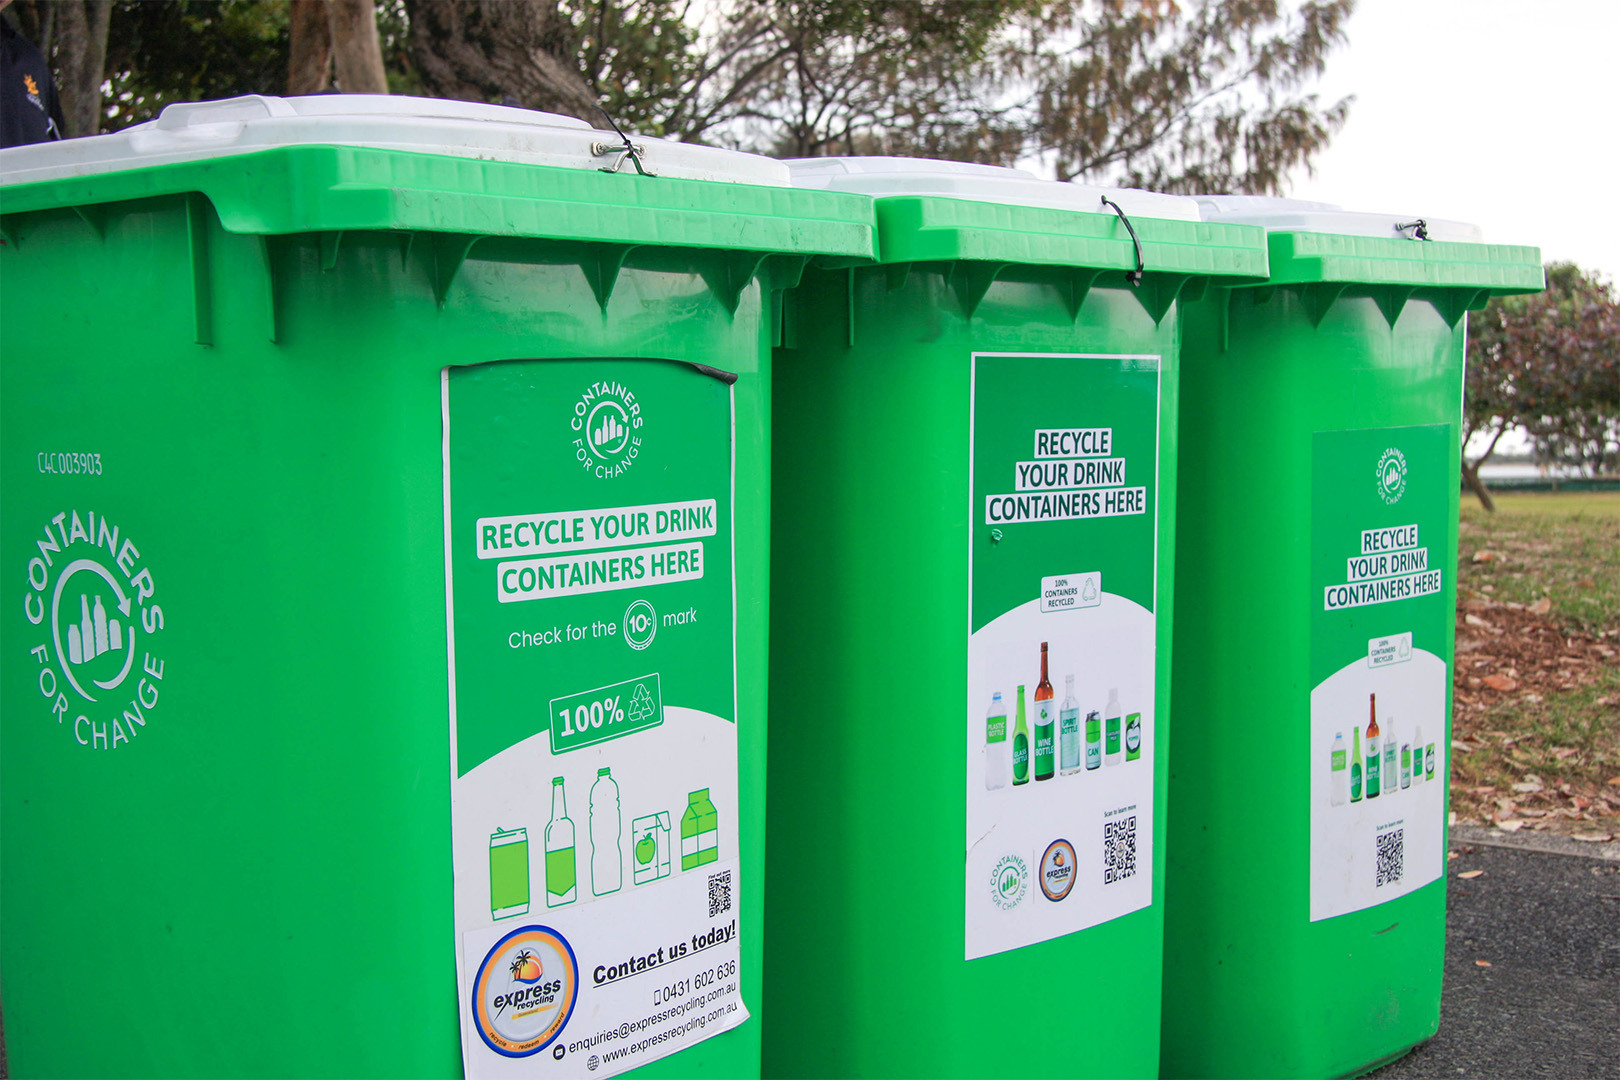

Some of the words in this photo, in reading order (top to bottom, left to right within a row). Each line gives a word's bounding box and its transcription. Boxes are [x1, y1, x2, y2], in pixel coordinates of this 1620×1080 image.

[571, 381, 643, 431] CONTAINERS
[572, 438, 593, 471] FOR
[595, 436, 642, 479] CHANGE
[1038, 431, 1109, 455] RECYCLE
[1018, 462, 1068, 488] YOUR
[1074, 460, 1123, 485] DRINK
[1376, 447, 1408, 478] CONTAINERS
[989, 492, 1100, 521] CONTAINERS
[1105, 489, 1143, 514] HERE
[482, 518, 584, 550] RECYCLE
[591, 512, 650, 540] YOUR
[656, 505, 713, 534] DRINK
[1364, 527, 1416, 552] RECYCLE
[25, 509, 164, 634] CONTAINERS
[502, 555, 645, 594] CONTAINERS
[651, 549, 700, 578] HERE
[1350, 556, 1388, 579] YOUR
[1391, 550, 1426, 573] DRINK
[1044, 587, 1078, 598] CONTAINERS
[1055, 579, 1069, 587] 100%
[1327, 578, 1411, 608] CONTAINERS
[1413, 572, 1439, 594] HERE
[1048, 597, 1075, 607] RECYCLED
[508, 627, 562, 649] Check
[566, 624, 588, 642] for
[592, 620, 617, 638] the
[663, 607, 697, 627] mark
[30, 644, 69, 724] FOR
[74, 652, 165, 750] CHANGE
[559, 696, 625, 737] 100%
[1037, 737, 1052, 748] WINE
[1087, 747, 1099, 757] CAN
[990, 854, 1028, 886] CONTAINERS
[1046, 866, 1072, 880] express
[593, 946, 664, 984] Contact
[668, 942, 687, 960] us
[691, 919, 736, 951] today!
[493, 979, 562, 1013] express
[663, 978, 690, 1002] 0431
[694, 968, 714, 990] 602
[717, 959, 736, 981] 636
[517, 994, 555, 1011] recycling
[568, 982, 736, 1053] enquiries@expressrecycling.com.au
[489, 1032, 507, 1047] recycle
[518, 1039, 540, 1050] redeem
[549, 1012, 565, 1034] reward
[602, 1001, 738, 1064] www.expressrecycling.com.au
